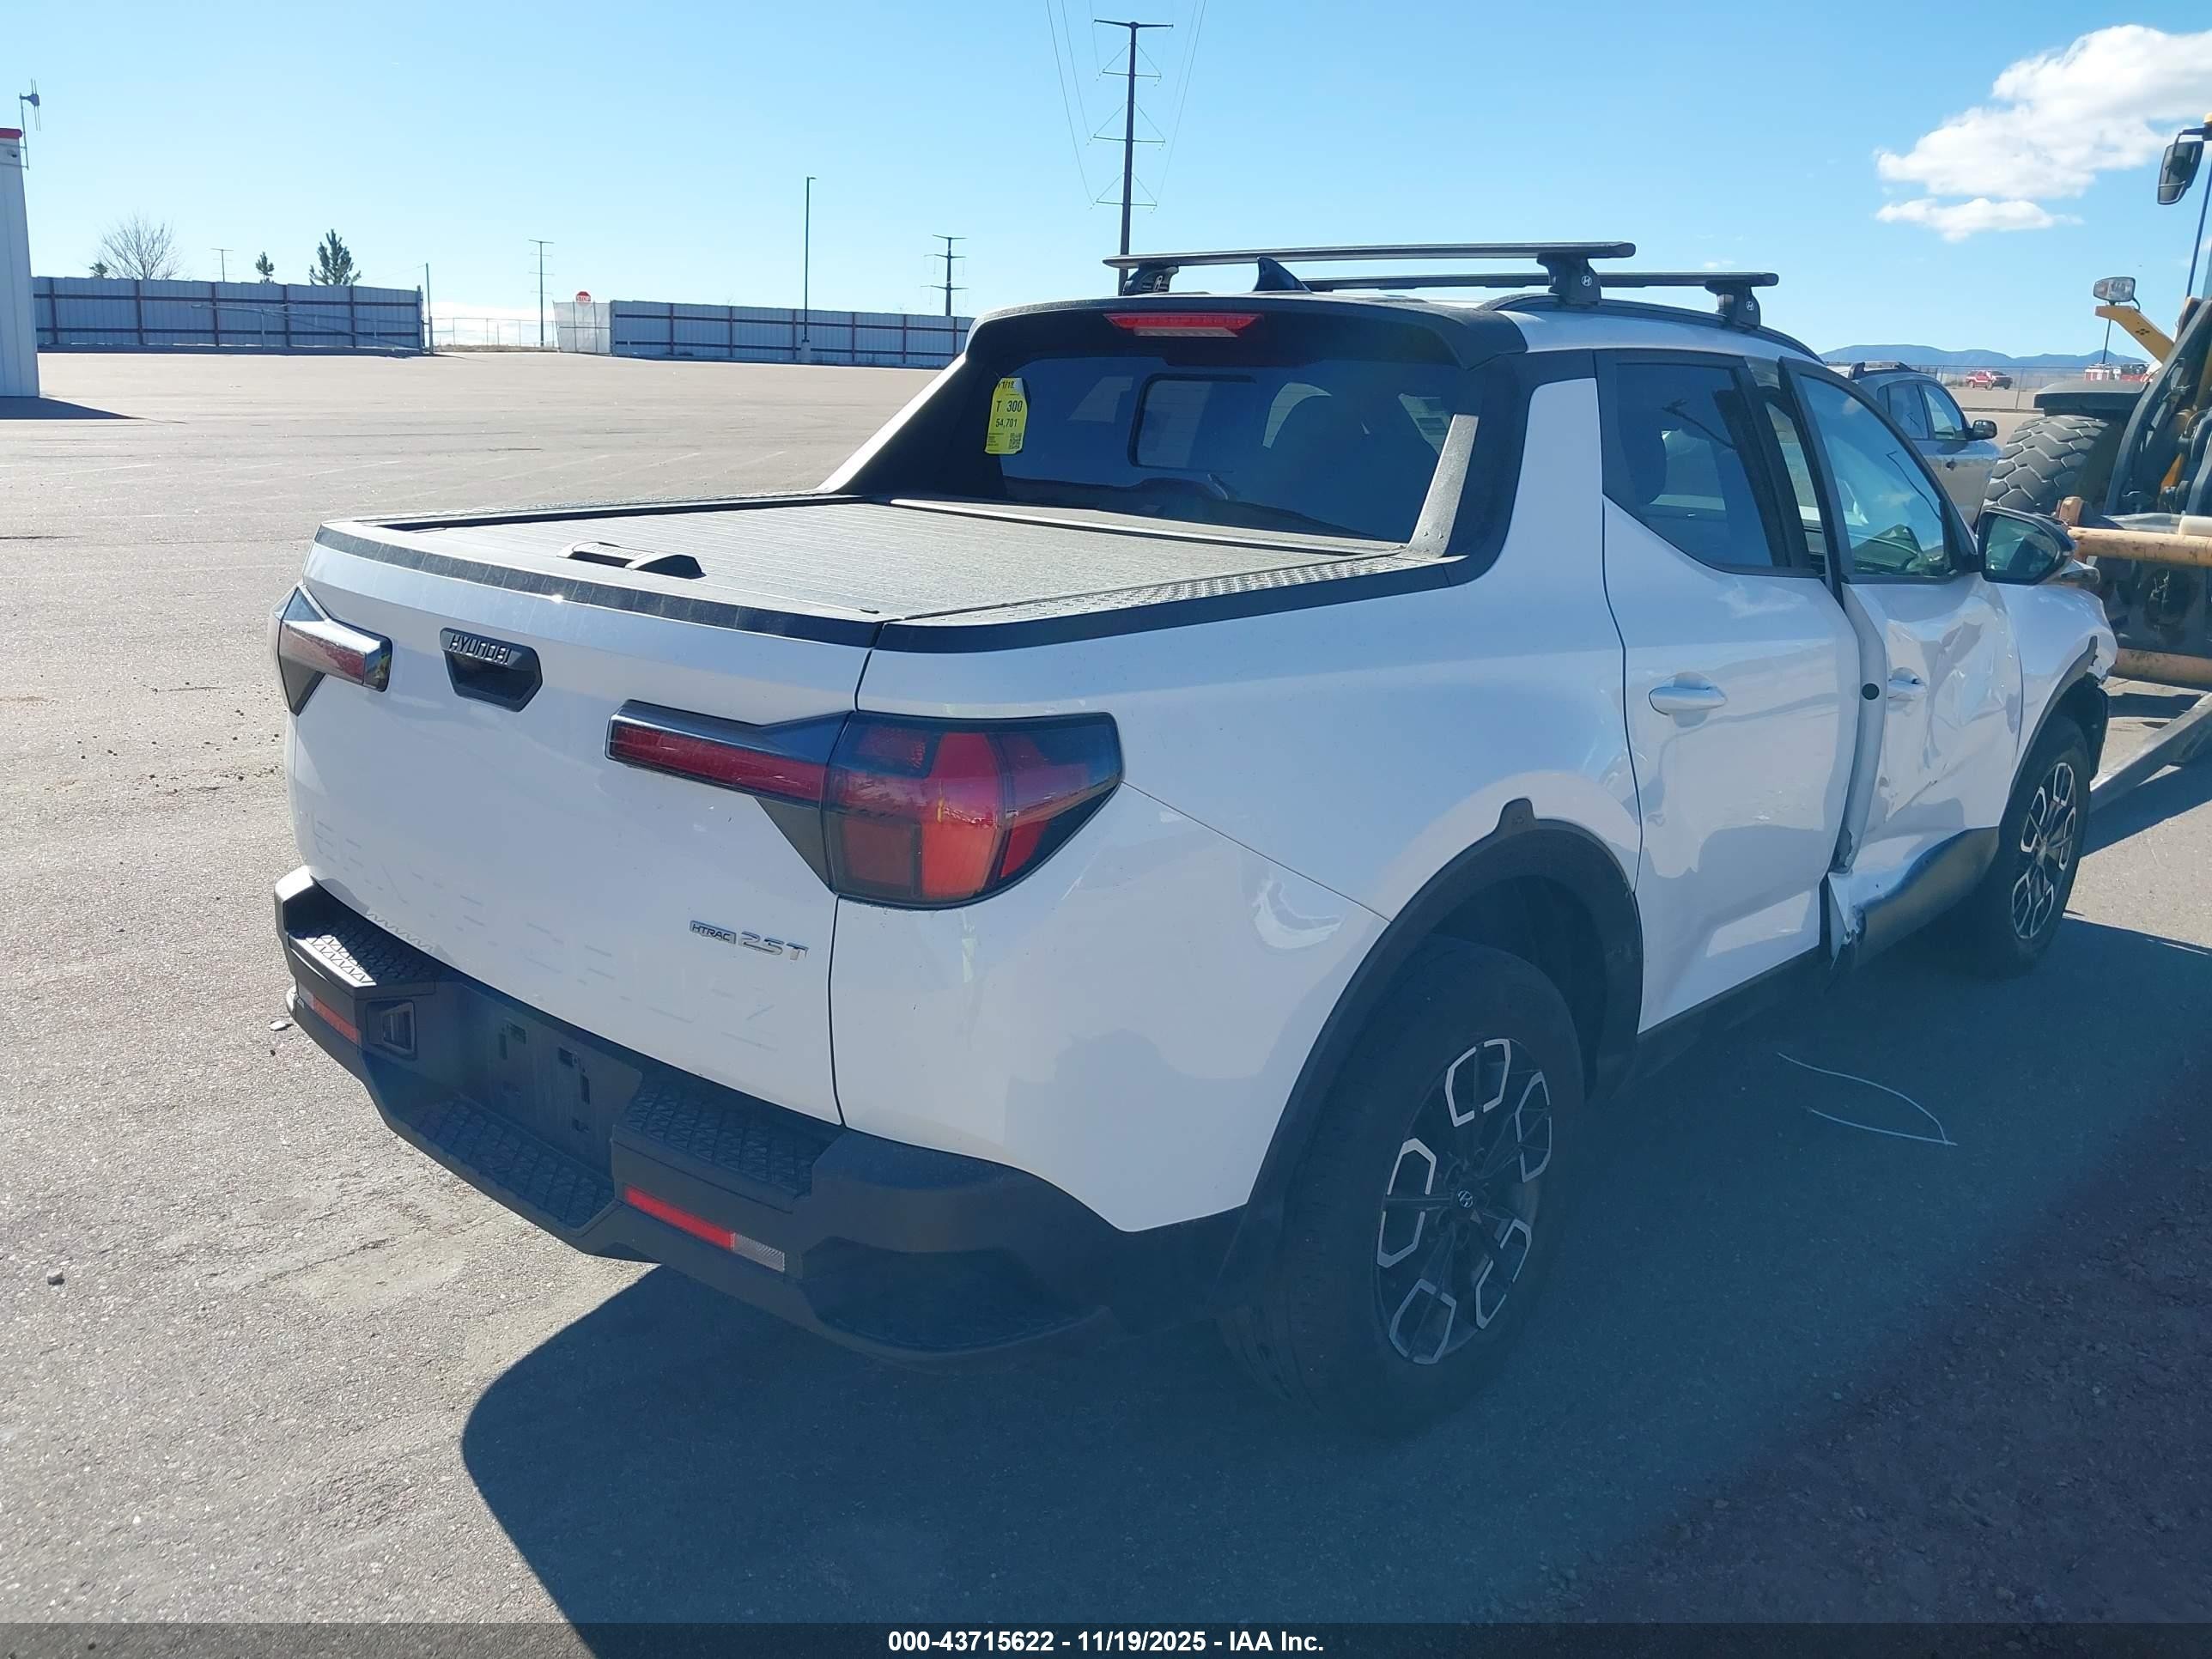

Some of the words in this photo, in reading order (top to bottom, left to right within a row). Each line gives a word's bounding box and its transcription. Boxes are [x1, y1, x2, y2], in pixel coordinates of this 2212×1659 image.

[996, 400, 1002, 412] T
[1006, 400, 1023, 412] 300
[996, 418, 1018, 428] 54,701
[448, 635, 513, 665] HYUNDAI
[691, 923, 731, 942] HTRAC
